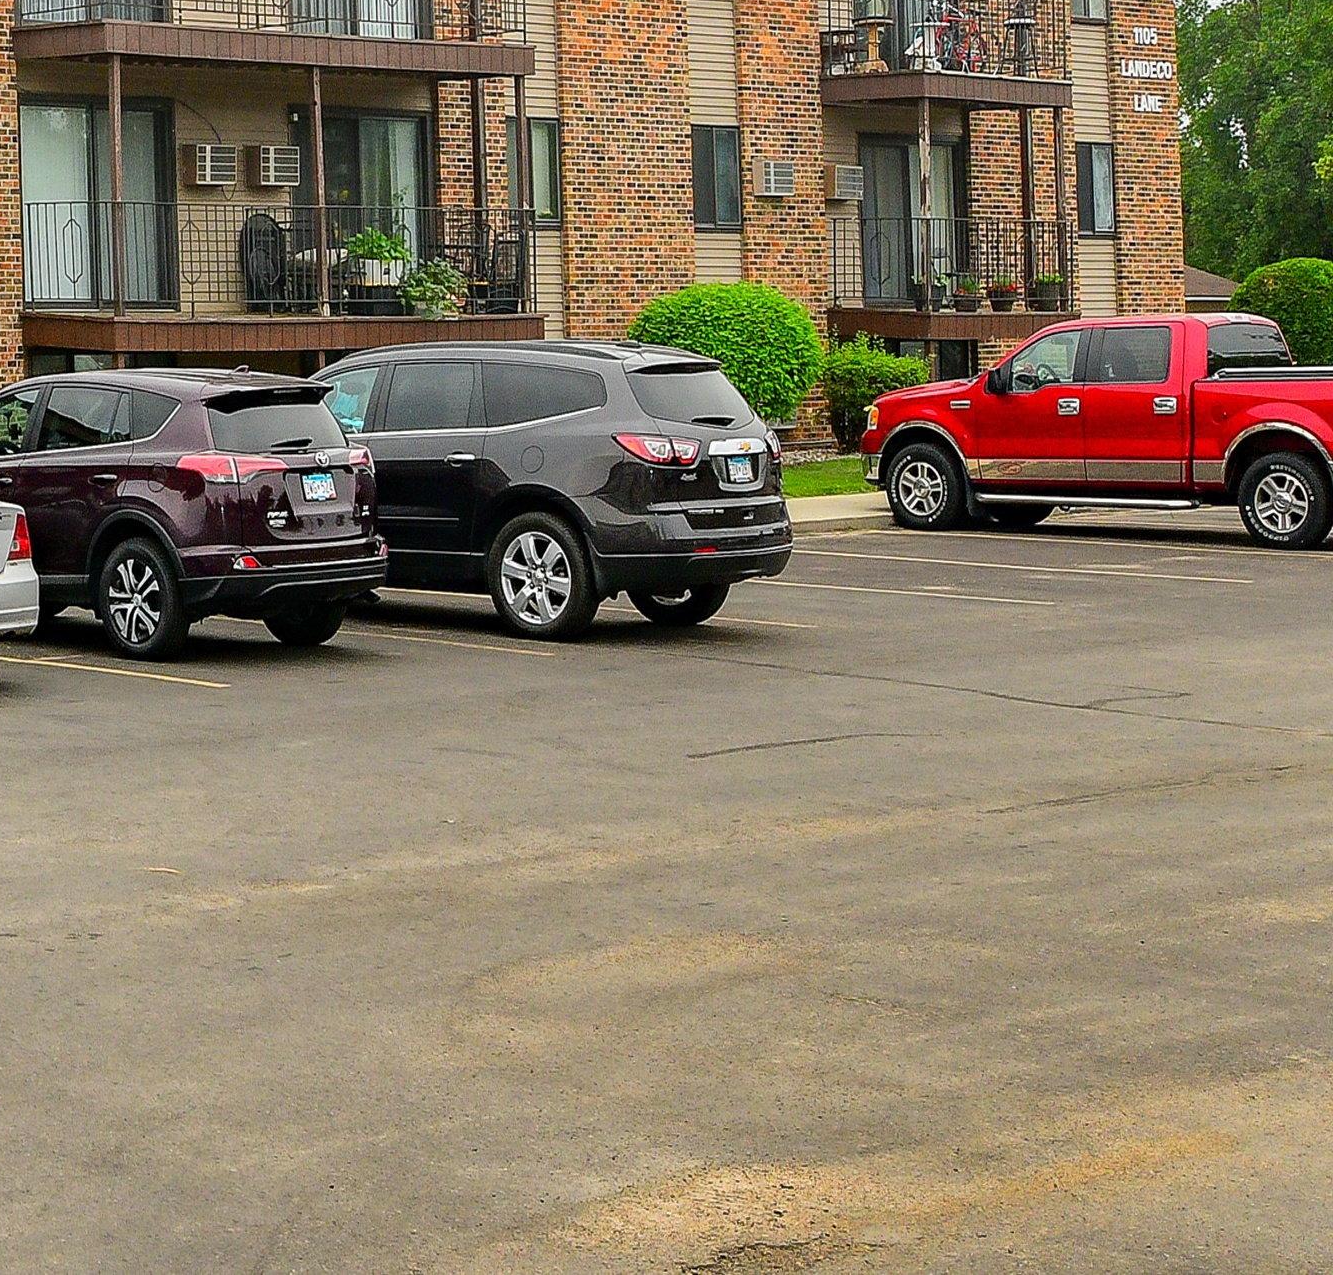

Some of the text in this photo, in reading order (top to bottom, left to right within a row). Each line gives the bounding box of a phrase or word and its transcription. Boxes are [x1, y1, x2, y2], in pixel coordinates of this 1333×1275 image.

[1133, 27, 1158, 45] 1105
[1121, 59, 1173, 79] LANDECO
[1134, 94, 1163, 113] LANE
